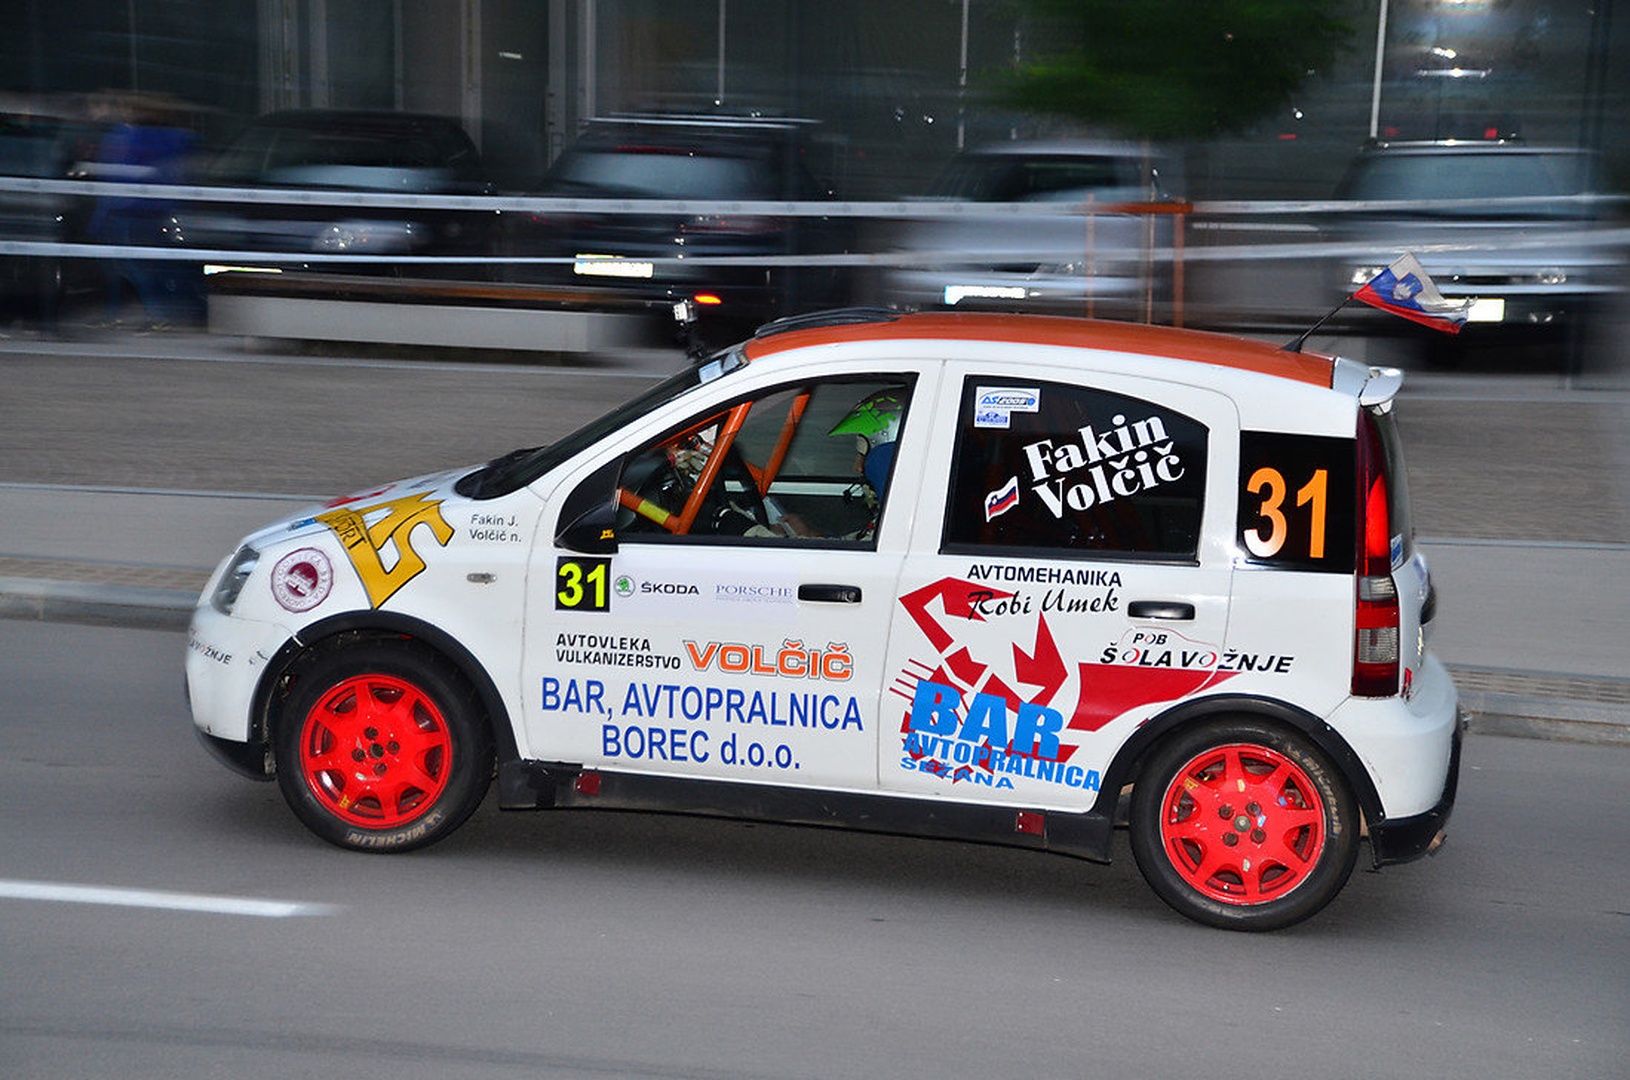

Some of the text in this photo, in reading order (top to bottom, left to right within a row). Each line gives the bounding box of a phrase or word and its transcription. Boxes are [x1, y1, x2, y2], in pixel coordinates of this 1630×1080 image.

[1023, 414, 1169, 483] Fakin
[1032, 441, 1185, 519] Volčič
[471, 514, 519, 527] Fakin J.
[1244, 466, 1328, 559] 31
[469, 528, 522, 542] Volčič n.
[557, 563, 607, 609] 31
[641, 581, 699, 596] ŠKODA
[715, 584, 793, 598] PORSCHE
[966, 564, 1123, 588] AVTOMEHANIKA
[967, 588, 1119, 620] Robi Umek
[556, 634, 652, 652] AVTOVLEKA
[556, 649, 682, 670] VULKANIZERSTVO
[1099, 642, 1294, 674] ŠOLA VOŽNJE
[683, 639, 855, 682] VOLČIČ
[542, 677, 864, 731] BAR, AVTOPRALNICA
[909, 678, 1066, 760] BAR
[602, 724, 801, 769] BOREC d.o.o.
[902, 732, 1101, 793] AVTOPRALNICA
[900, 756, 1015, 790] SEŽANA
[347, 825, 427, 847] MICHELIN
